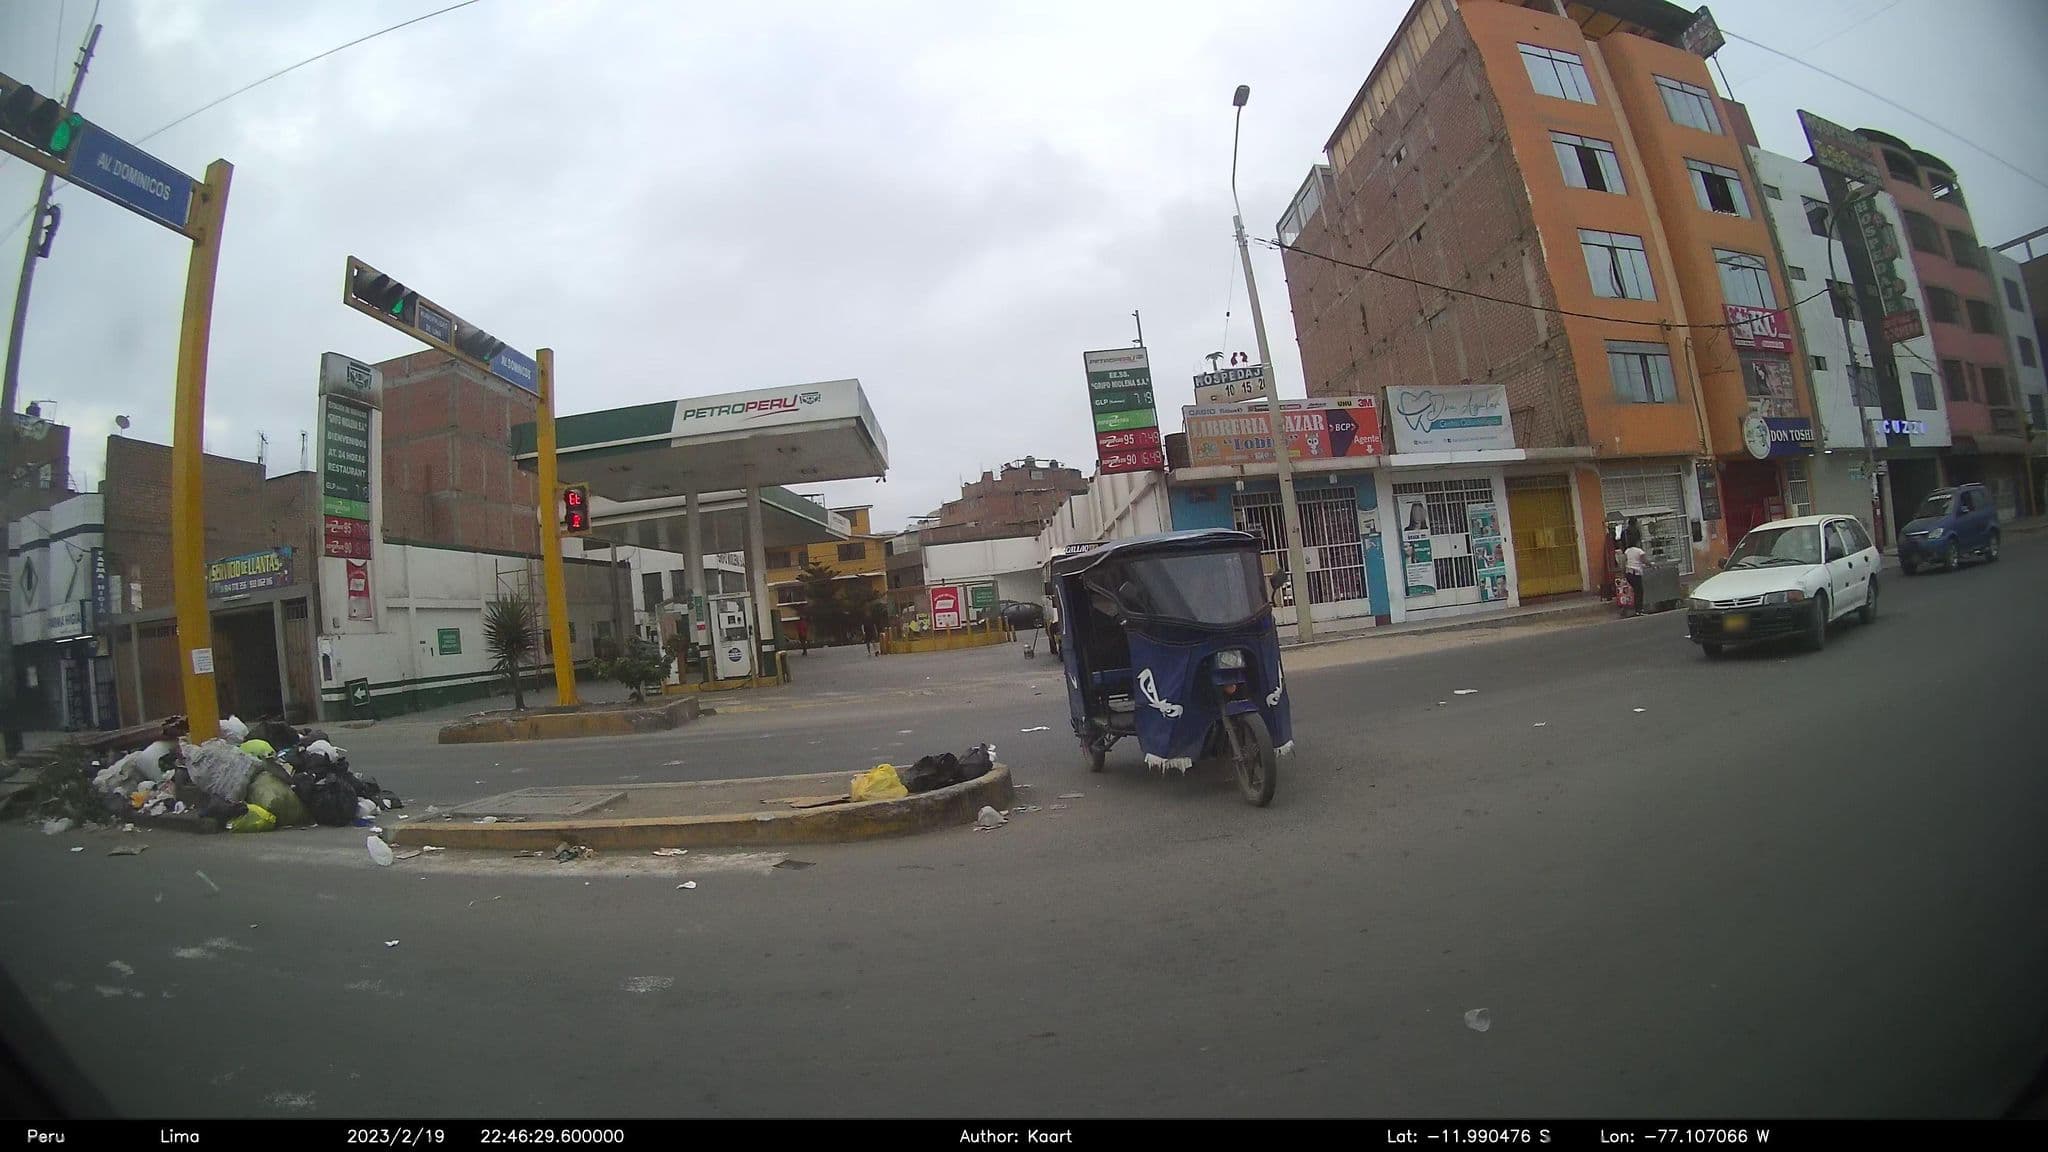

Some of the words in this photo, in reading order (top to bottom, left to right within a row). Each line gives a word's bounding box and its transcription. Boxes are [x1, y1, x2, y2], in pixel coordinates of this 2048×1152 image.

[113, 160, 171, 200] DOMINICOS
[1195, 368, 1263, 387] HOSPEDAJ
[1225, 383, 1235, 397] 10
[1242, 381, 1252, 393] 15
[683, 394, 798, 421] PETROPERU
[1358, 398, 1373, 408] 3M
[1191, 417, 1269, 439] LIBRERIA
[1283, 414, 1325, 433] AZAR
[1335, 423, 1351, 432] BCP
[327, 431, 366, 449] BIENVENIDOS
[1123, 433, 1135, 445] 95
[1354, 434, 1380, 445] Agente
[1770, 430, 1789, 442] DON
[1789, 429, 1815, 442] TOSHI
[1126, 454, 1137, 465] 90
[327, 462, 366, 478] RESTAURANT
[248, 554, 280, 576] LLANTAS
